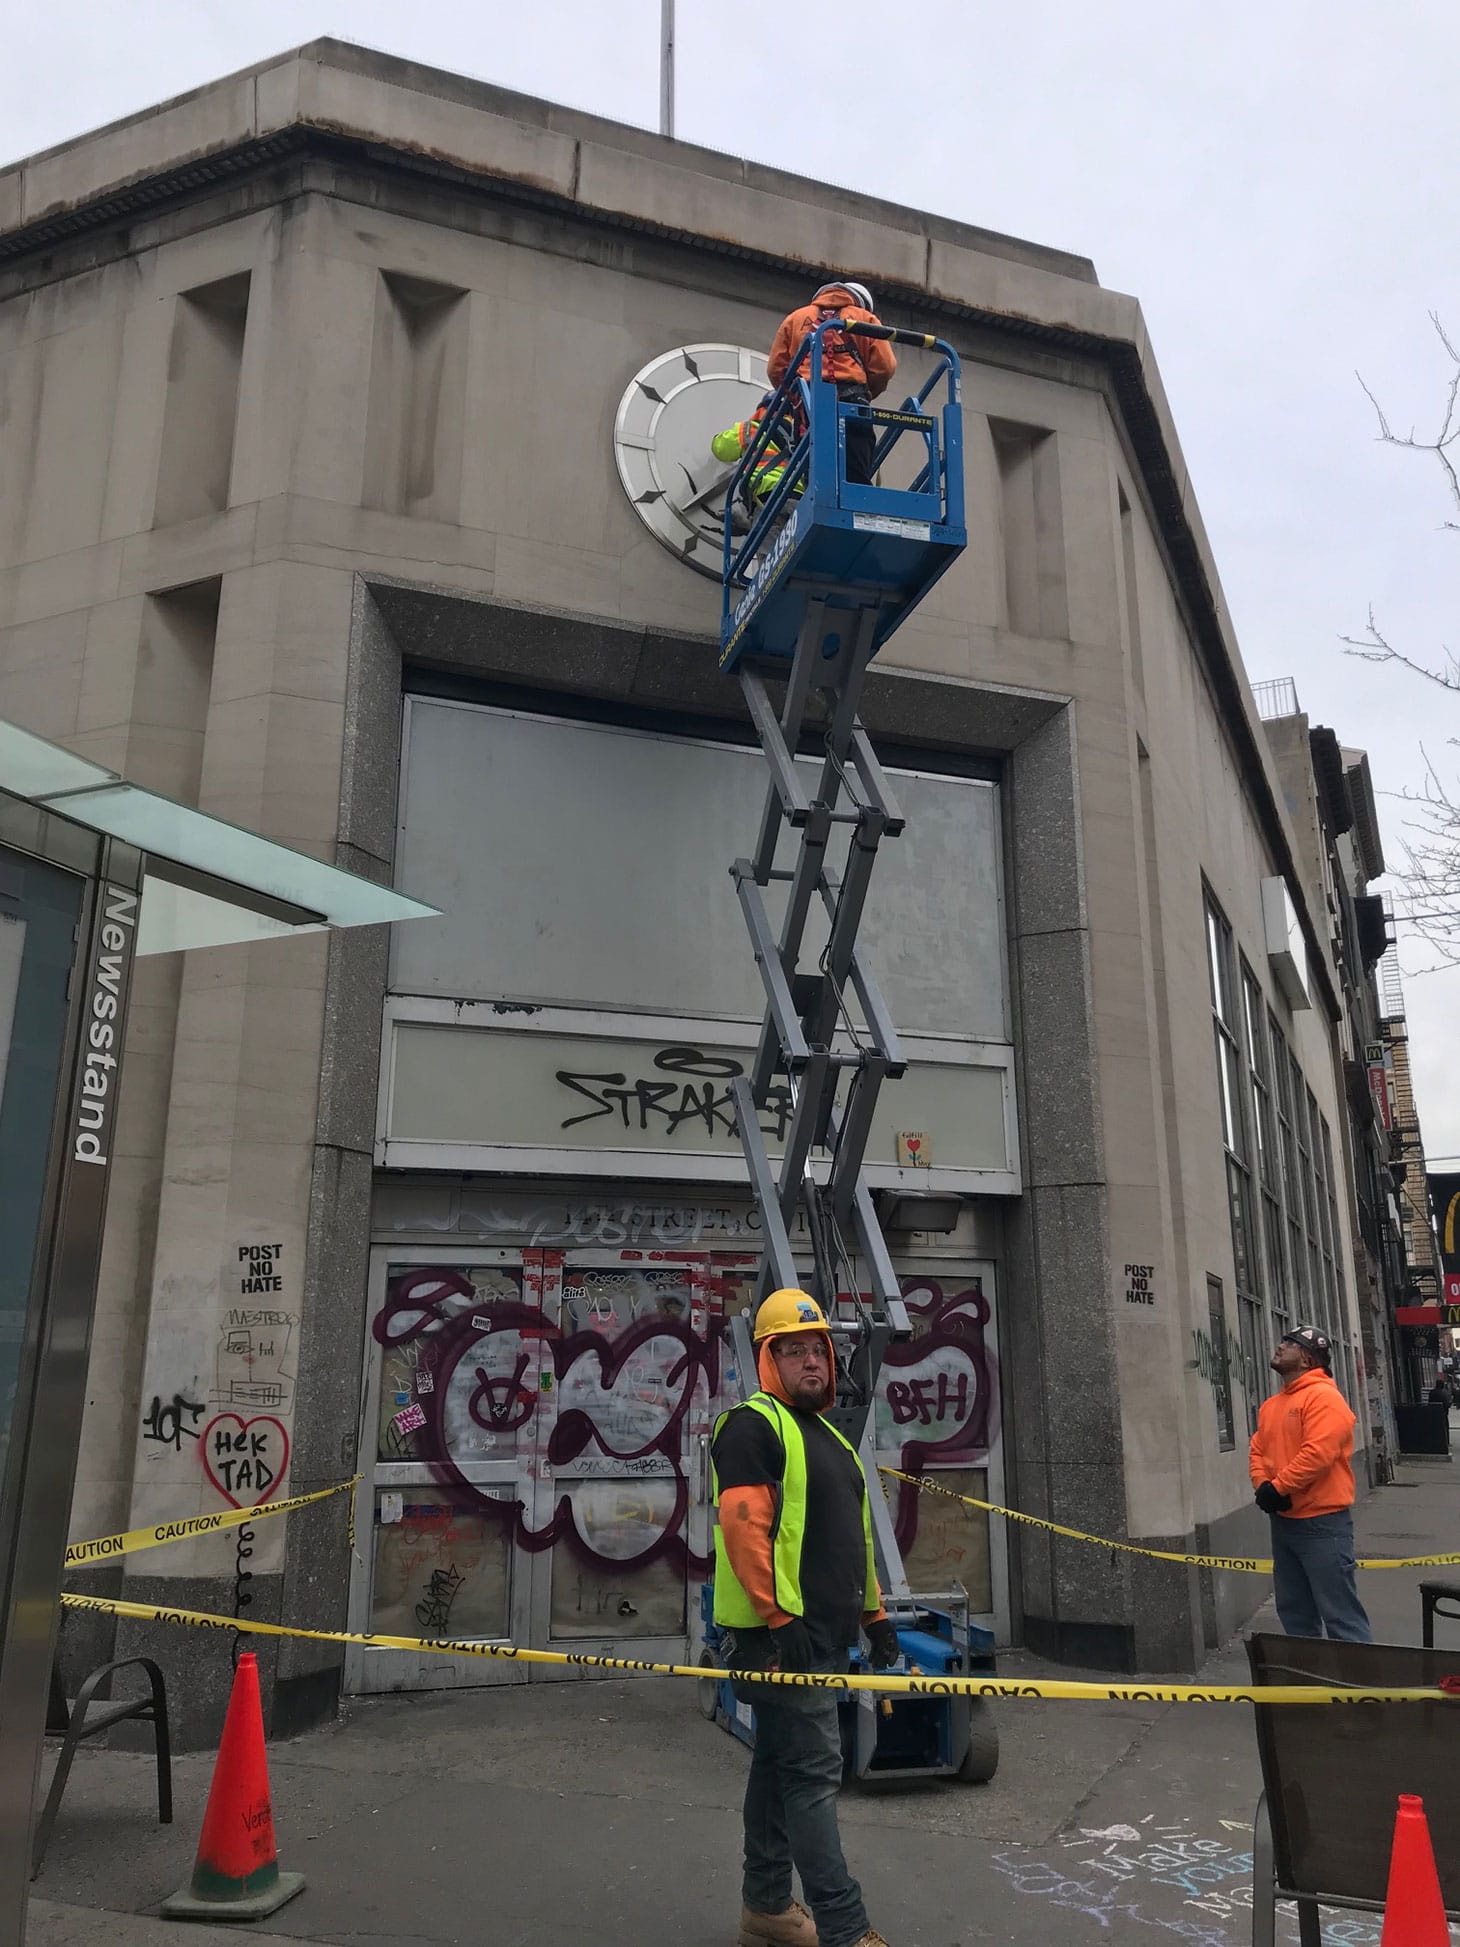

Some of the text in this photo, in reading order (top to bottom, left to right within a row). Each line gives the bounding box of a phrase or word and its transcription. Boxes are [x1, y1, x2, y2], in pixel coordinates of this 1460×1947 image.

[74, 886, 138, 1167] Newsstand
[238, 1244, 283, 1261] POST
[249, 1261, 273, 1276] NO
[1124, 1264, 1154, 1278] POST
[241, 1276, 282, 1294] HATE
[1131, 1278, 1148, 1291] NO
[1126, 1291, 1154, 1305] HATE
[218, 1459, 273, 1491] TAD
[65, 1537, 123, 1562] AUTION
[155, 1515, 222, 1541] CAUTION
[1184, 1556, 1257, 1571] CAUTION
